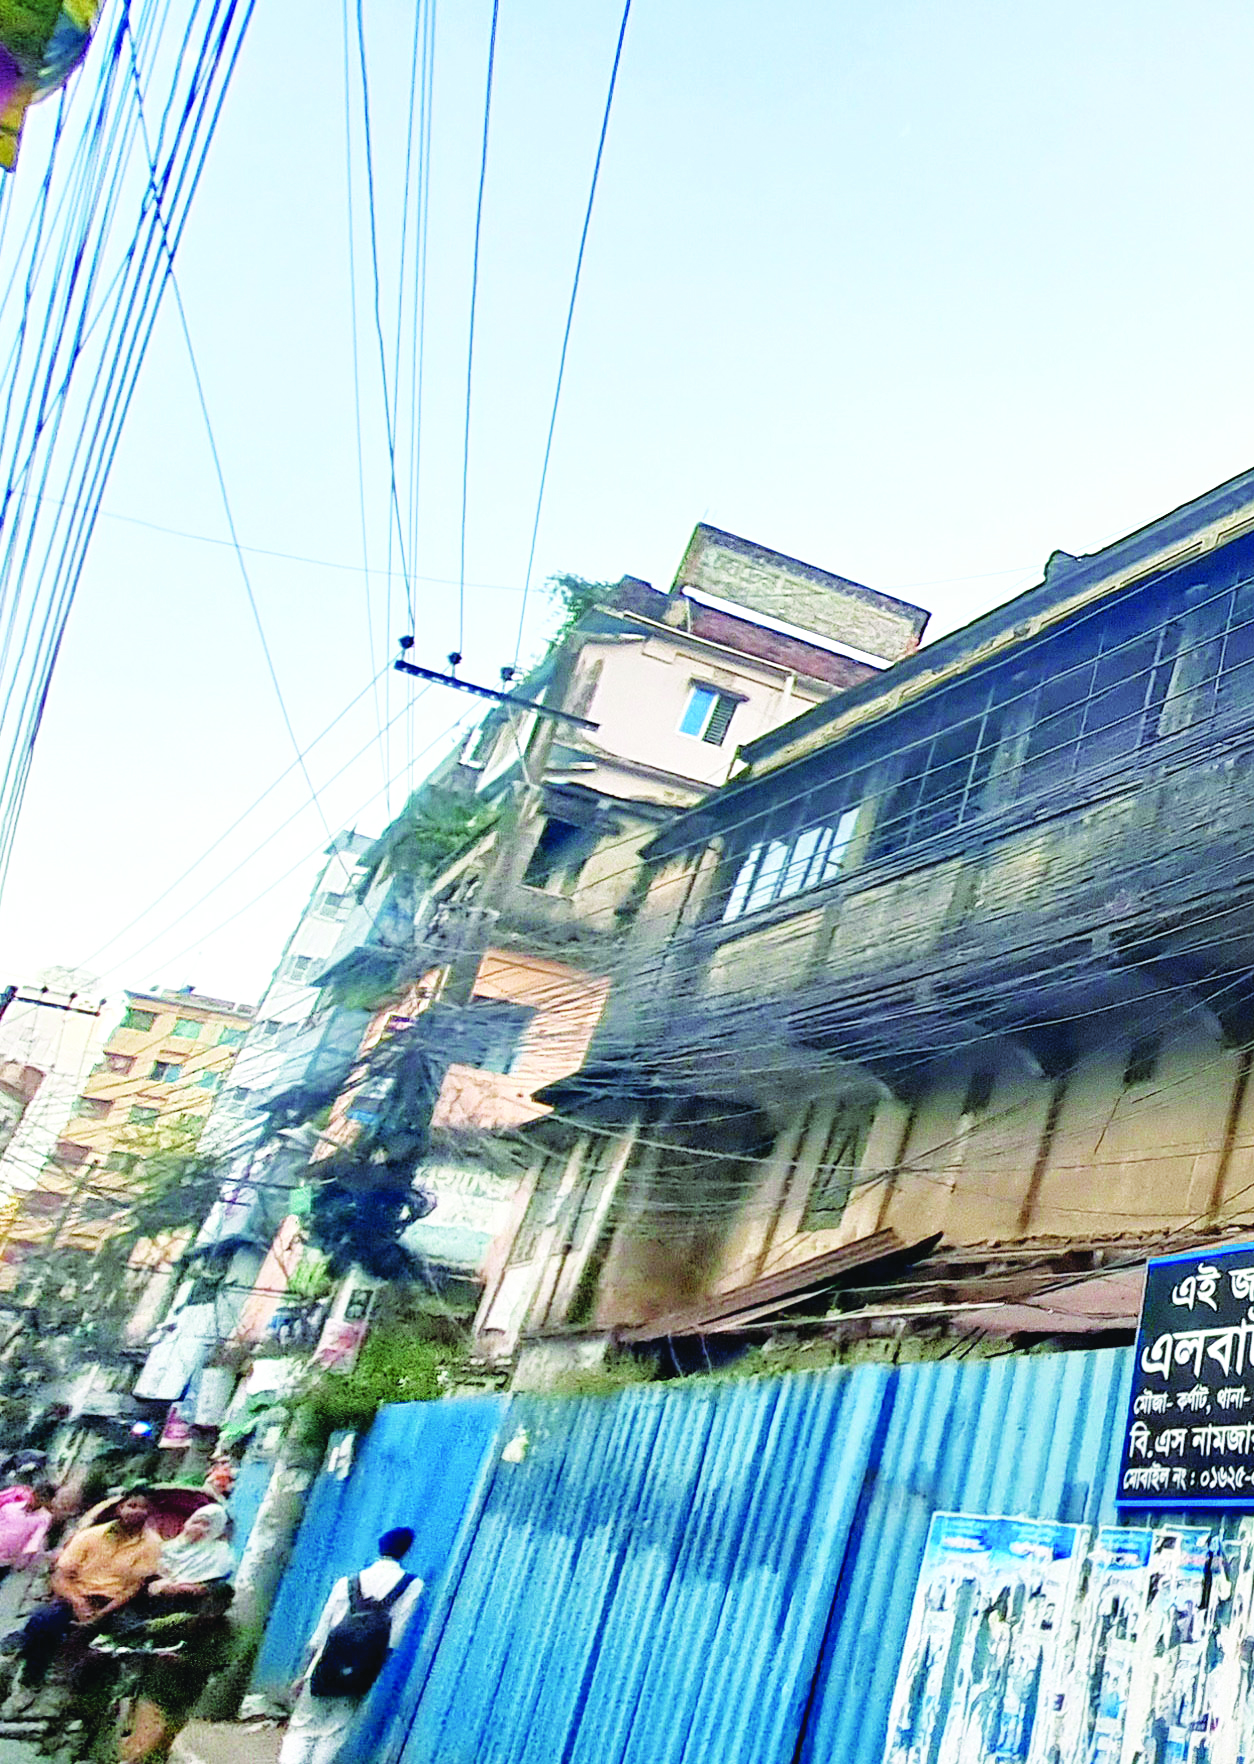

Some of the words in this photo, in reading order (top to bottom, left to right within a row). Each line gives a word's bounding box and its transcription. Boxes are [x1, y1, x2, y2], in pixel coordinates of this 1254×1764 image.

[1172, 1263, 1221, 1312] এই
[1129, 1421, 1188, 1459] বি.এস
[1123, 1461, 1170, 1491] মোবাইল
